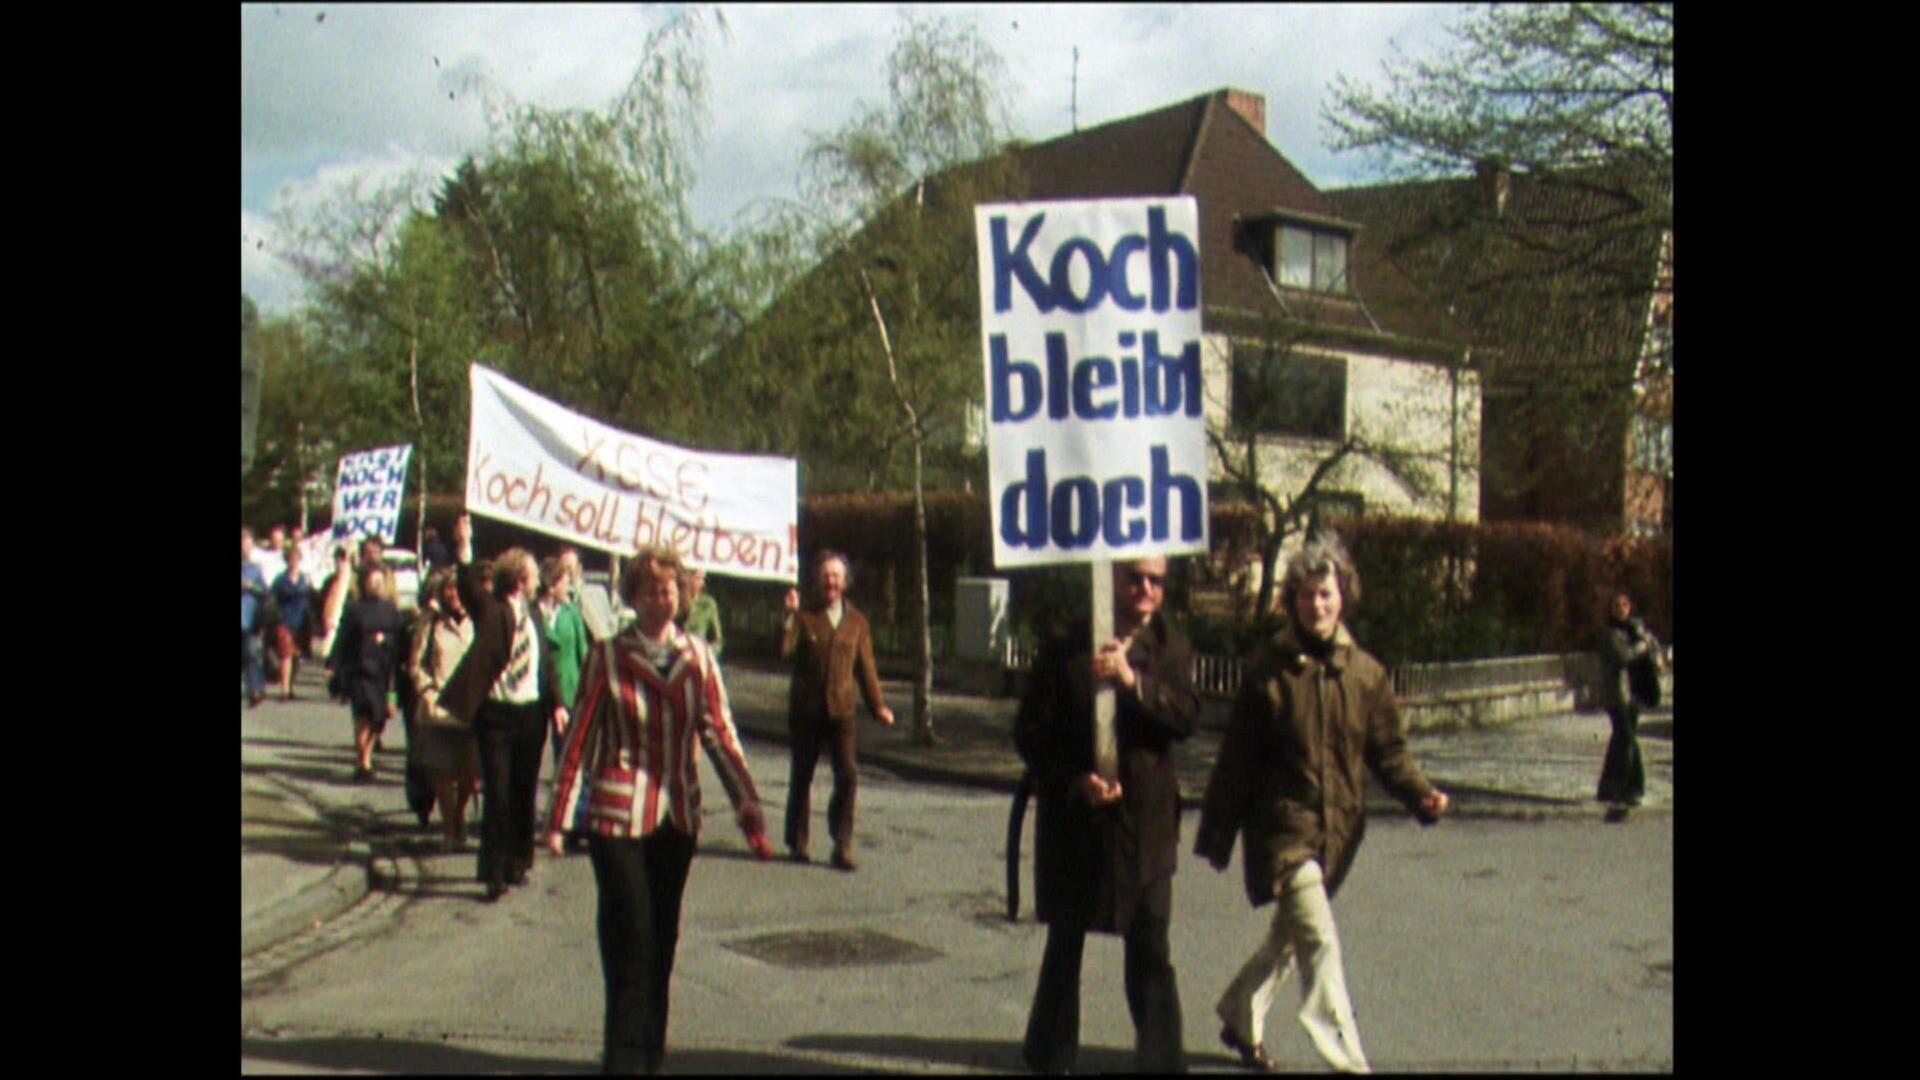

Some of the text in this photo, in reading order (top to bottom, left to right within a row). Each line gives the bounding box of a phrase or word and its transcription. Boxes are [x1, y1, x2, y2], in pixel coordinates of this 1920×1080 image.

[990, 205, 1198, 314] Koch
[989, 329, 1202, 423] bleibt
[340, 465, 404, 487] KOCH
[343, 490, 398, 512] WER
[473, 440, 552, 520] Koch
[555, 492, 621, 544] soll
[1000, 445, 1202, 550] doch
